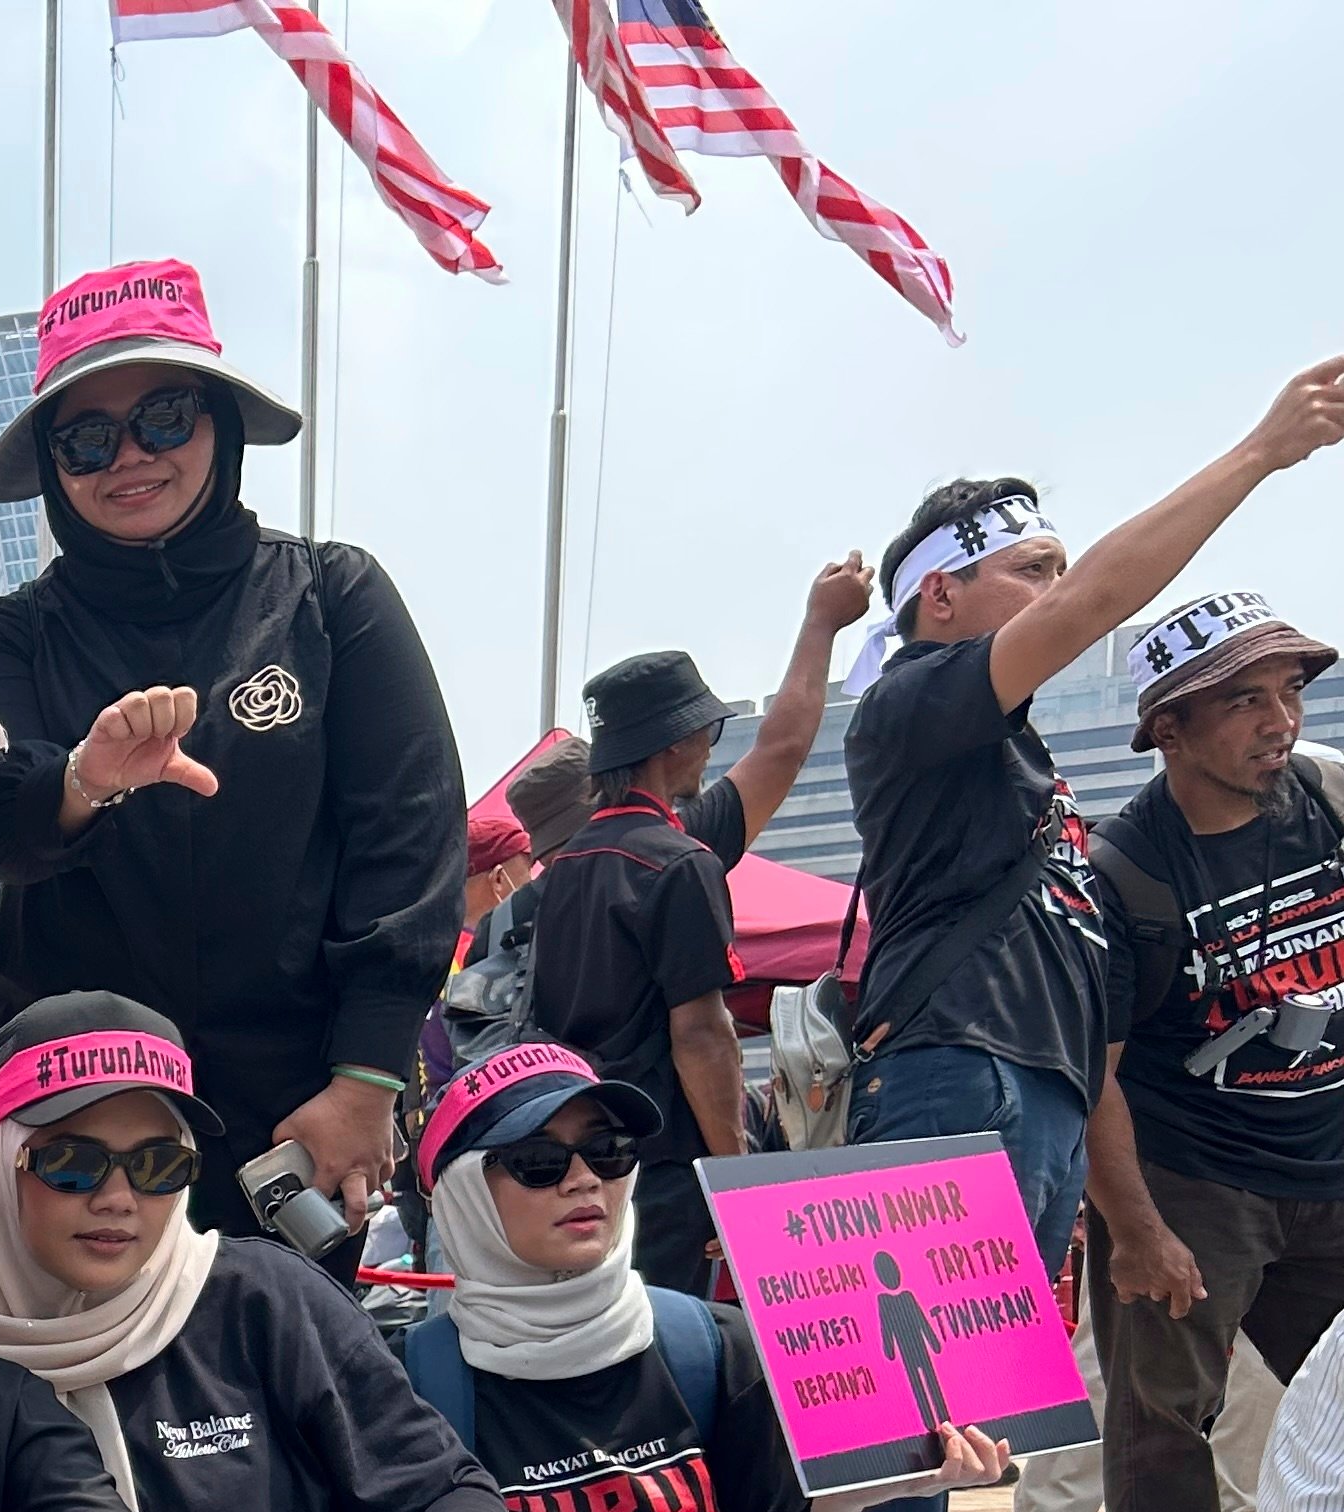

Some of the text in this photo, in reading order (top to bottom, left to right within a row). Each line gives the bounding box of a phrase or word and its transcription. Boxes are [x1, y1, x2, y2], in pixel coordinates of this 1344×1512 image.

[44, 278, 183, 335] #TurunAnwar
[36, 1040, 187, 1089] #TurunAnwar
[783, 1181, 969, 1247] #TURUN ANWAR
[925, 1236, 1019, 1286] TAPI TAK
[758, 1263, 868, 1307] BENCI LELAKI
[775, 1315, 863, 1357] YANG RETI
[929, 1285, 1042, 1343] TUNAIKAN!
[792, 1365, 878, 1410] BERJANJI
[155, 1420, 187, 1441] New
[212, 1432, 250, 1453] Club
[523, 1451, 590, 1481] RAKYAT
